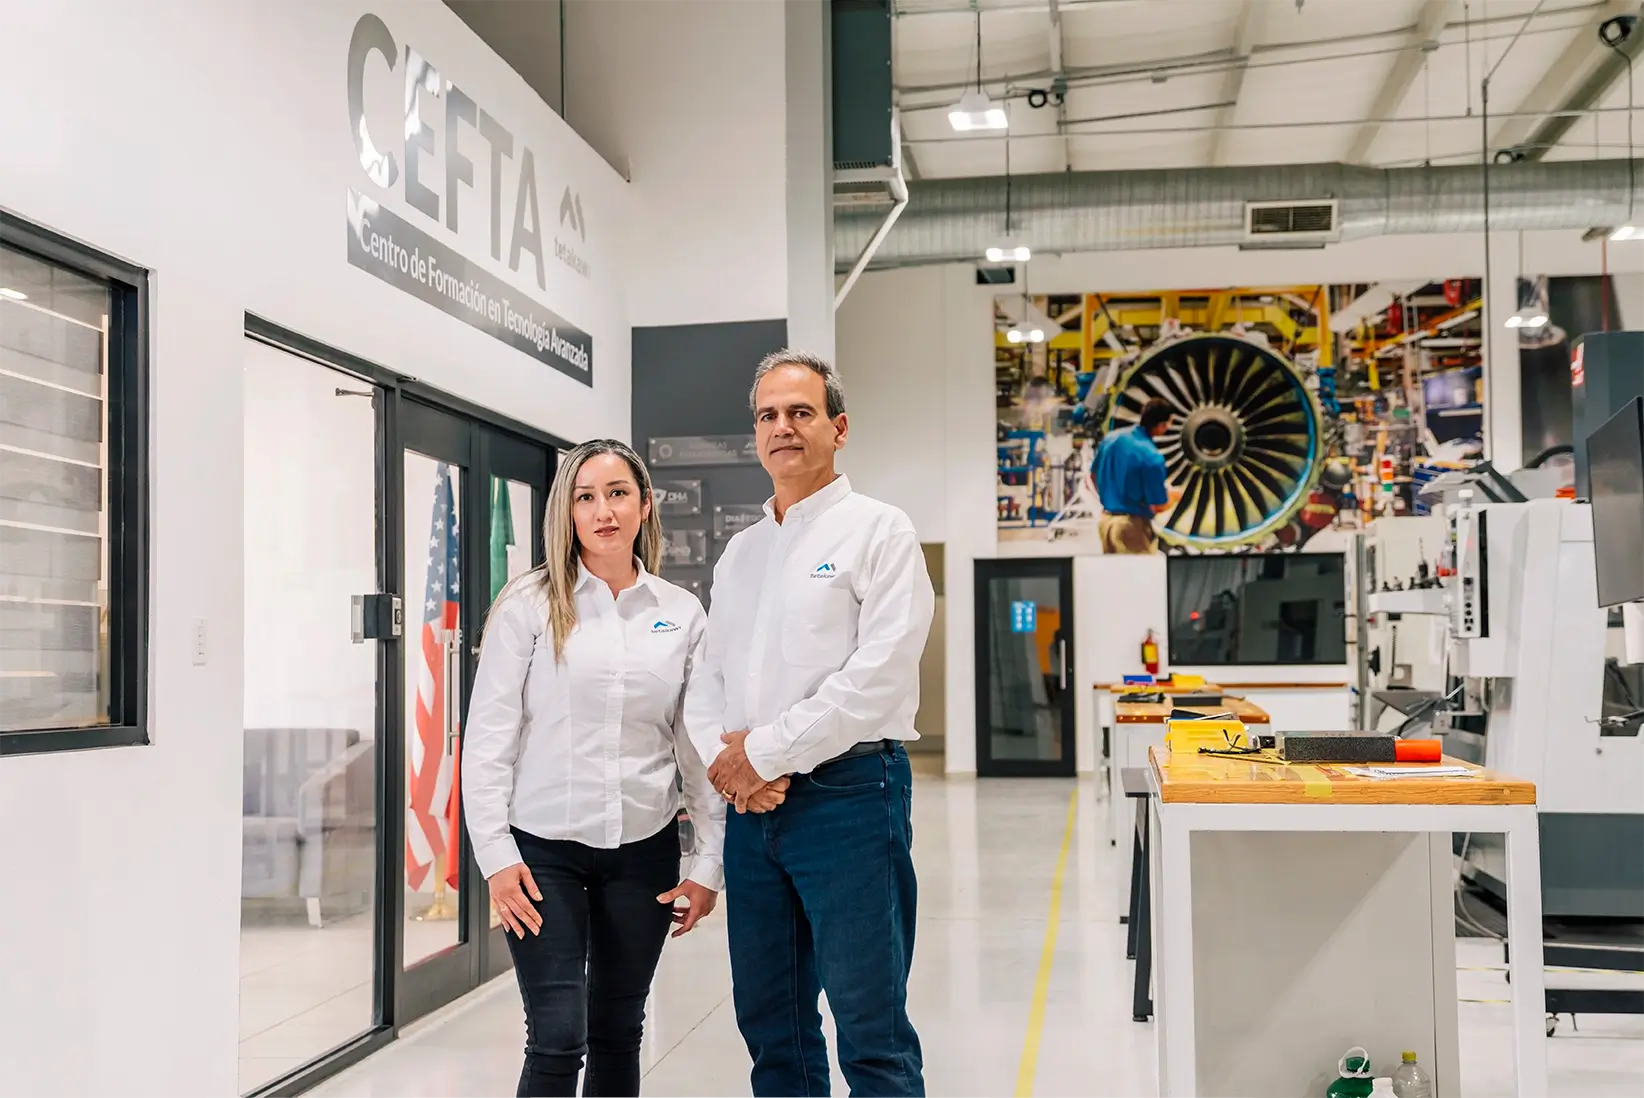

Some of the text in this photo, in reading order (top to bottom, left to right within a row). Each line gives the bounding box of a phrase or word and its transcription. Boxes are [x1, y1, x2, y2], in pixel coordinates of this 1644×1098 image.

[347, 13, 546, 292] CEFTA
[360, 218, 588, 372] Centro de Formación en Tecnología Avanzada
